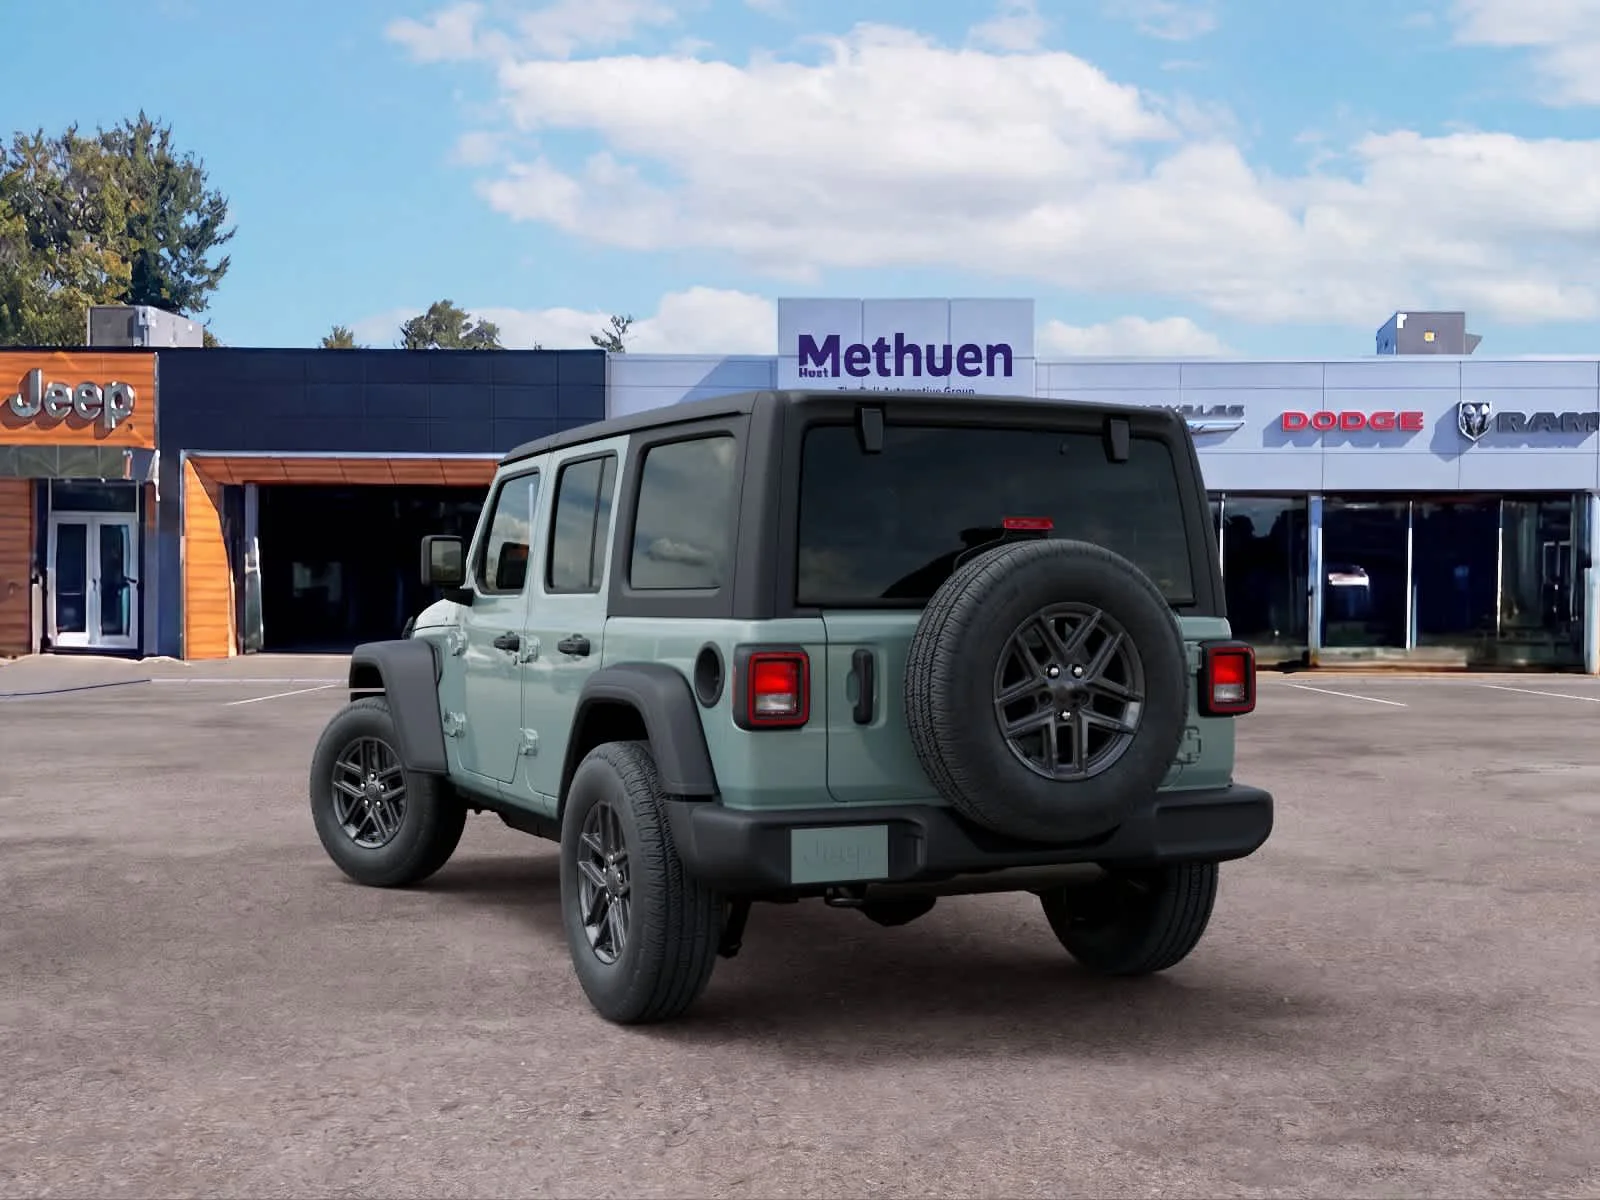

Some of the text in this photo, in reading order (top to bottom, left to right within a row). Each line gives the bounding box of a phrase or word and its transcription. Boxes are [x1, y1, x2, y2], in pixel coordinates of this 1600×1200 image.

[798, 333, 1013, 378] Methuen
[9, 368, 136, 429] Jeep
[1281, 410, 1424, 432] DODGE
[1496, 411, 1599, 433] RAM
